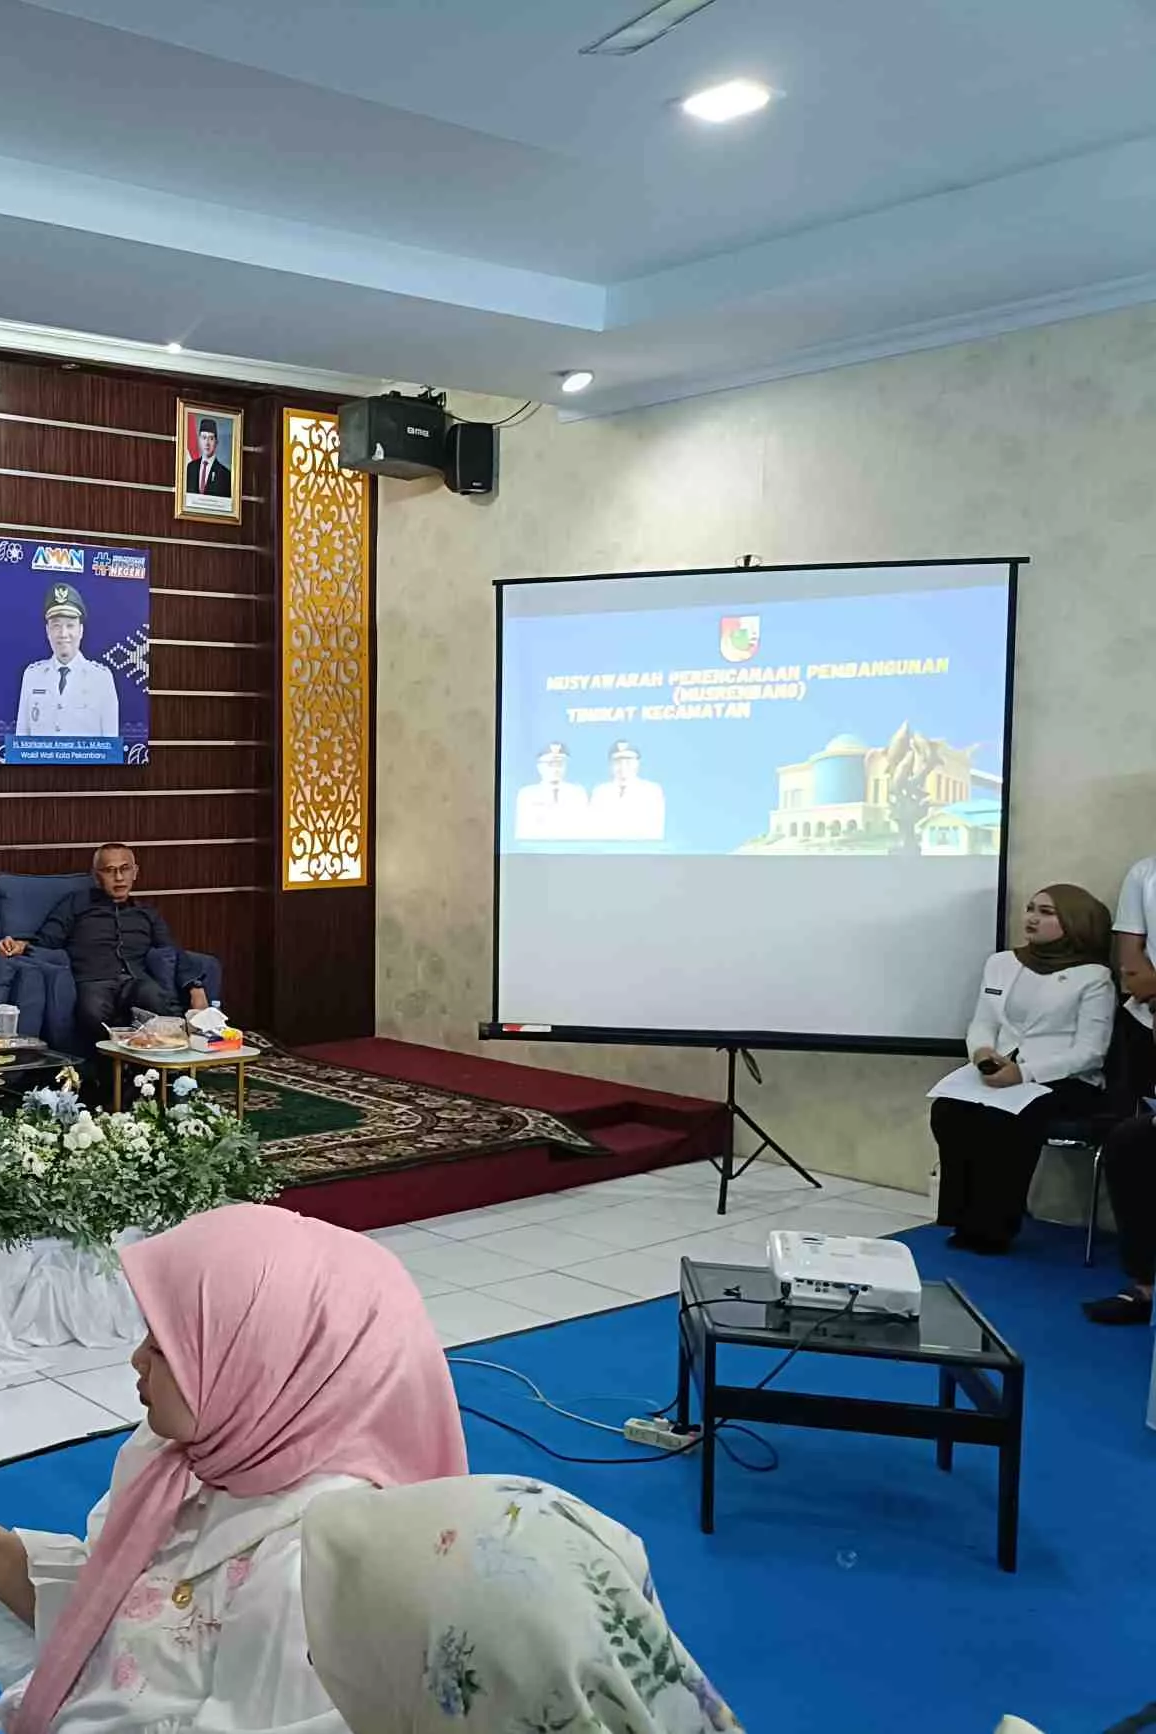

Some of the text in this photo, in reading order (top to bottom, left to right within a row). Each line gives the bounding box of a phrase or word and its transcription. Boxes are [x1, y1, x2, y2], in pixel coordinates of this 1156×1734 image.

[546, 671, 663, 691] MUSYAWARAH
[807, 657, 949, 680] PEMBANGUNAN
[641, 701, 751, 720] KECAMATAN
